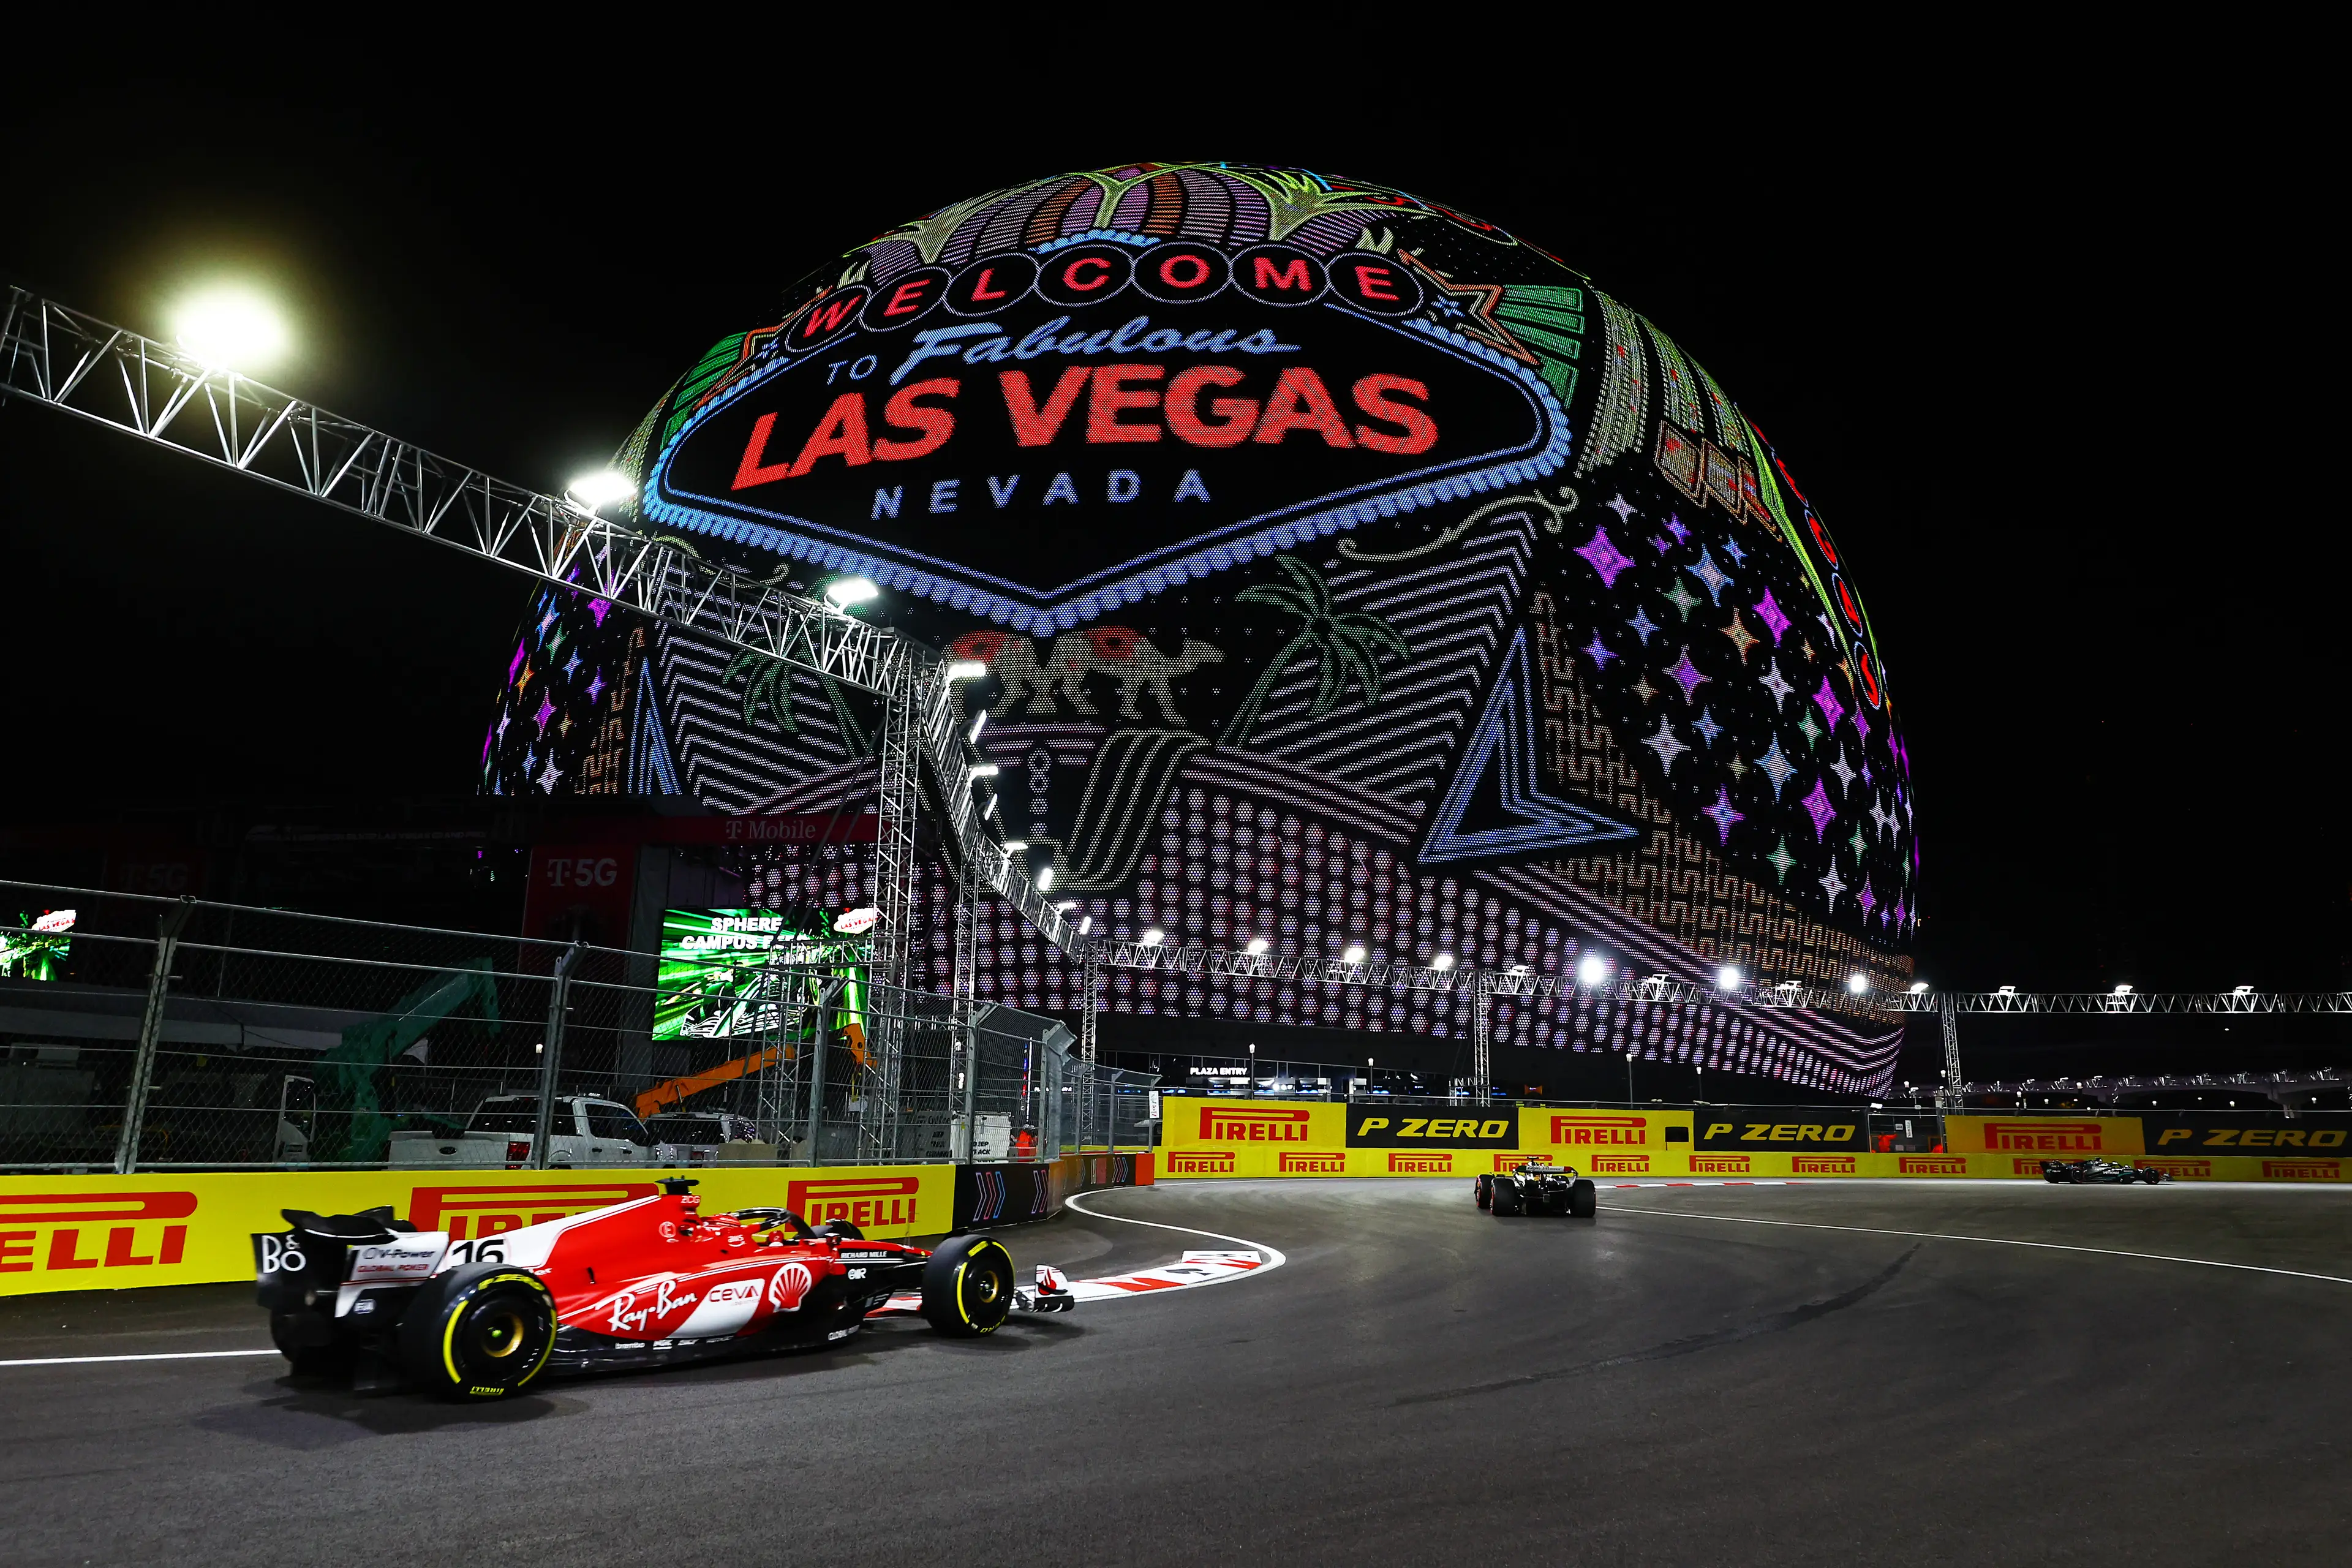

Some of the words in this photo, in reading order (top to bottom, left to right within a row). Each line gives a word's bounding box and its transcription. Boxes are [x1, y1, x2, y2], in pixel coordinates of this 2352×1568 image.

[803, 254, 1400, 338] WELCOME
[827, 355, 878, 385] TO
[889, 314, 1301, 386] Fabulous
[730, 370, 962, 491] LAS
[1000, 363, 1438, 455] VEGAS
[871, 469, 1210, 520] NEVADA
[748, 820, 816, 840] Mobile
[575, 858, 617, 886] 5G
[711, 917, 783, 932] SPHERE
[682, 935, 760, 950] CAMPUS
[1189, 1067, 1218, 1076] PLAZA
[1199, 1107, 1310, 1141] PIRELLI
[1357, 1117, 1389, 1137] P
[1396, 1118, 1509, 1138] ZERO
[1550, 1115, 1647, 1145] PIRELLI
[1703, 1123, 1733, 1140] P
[1740, 1125, 1855, 1141] ZERO
[1984, 1123, 2103, 1150] PIRELLI
[2157, 1129, 2193, 1146] P
[2203, 1129, 2348, 1147] ZERO
[1167, 1152, 1235, 1172] PIRELLI
[1279, 1153, 1346, 1172] PIRELLI
[1389, 1153, 1453, 1172] PIRELLI
[1591, 1155, 1649, 1172] PIRELLI
[1689, 1156, 1750, 1172] PIRELLI
[1792, 1156, 1856, 1173] PIRELLI
[1899, 1157, 1966, 1174] PIRELLI
[2263, 1161, 2340, 1178] PIRELLI
[453, 1239, 504, 1264] 16
[595, 1280, 698, 1332] Ray-Ban
